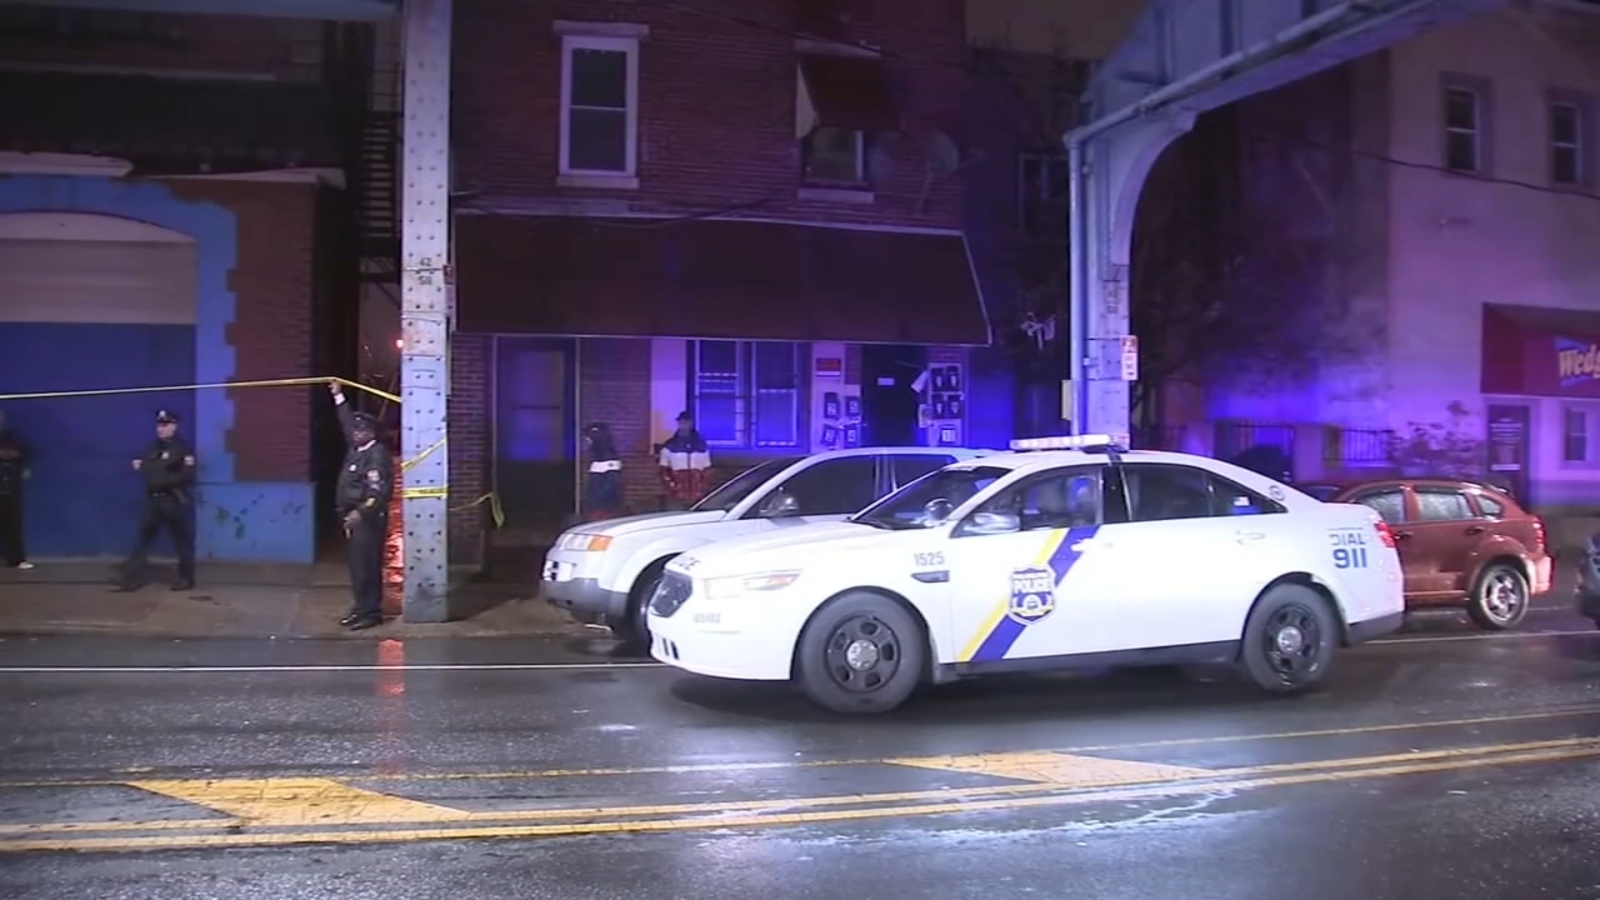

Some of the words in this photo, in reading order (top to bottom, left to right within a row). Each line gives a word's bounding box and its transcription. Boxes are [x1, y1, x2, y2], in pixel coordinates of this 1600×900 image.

[1329, 533, 1367, 546] DIAL
[914, 551, 945, 566] 1525
[1332, 548, 1368, 569] 911
[1012, 578, 1051, 596] POLICE
